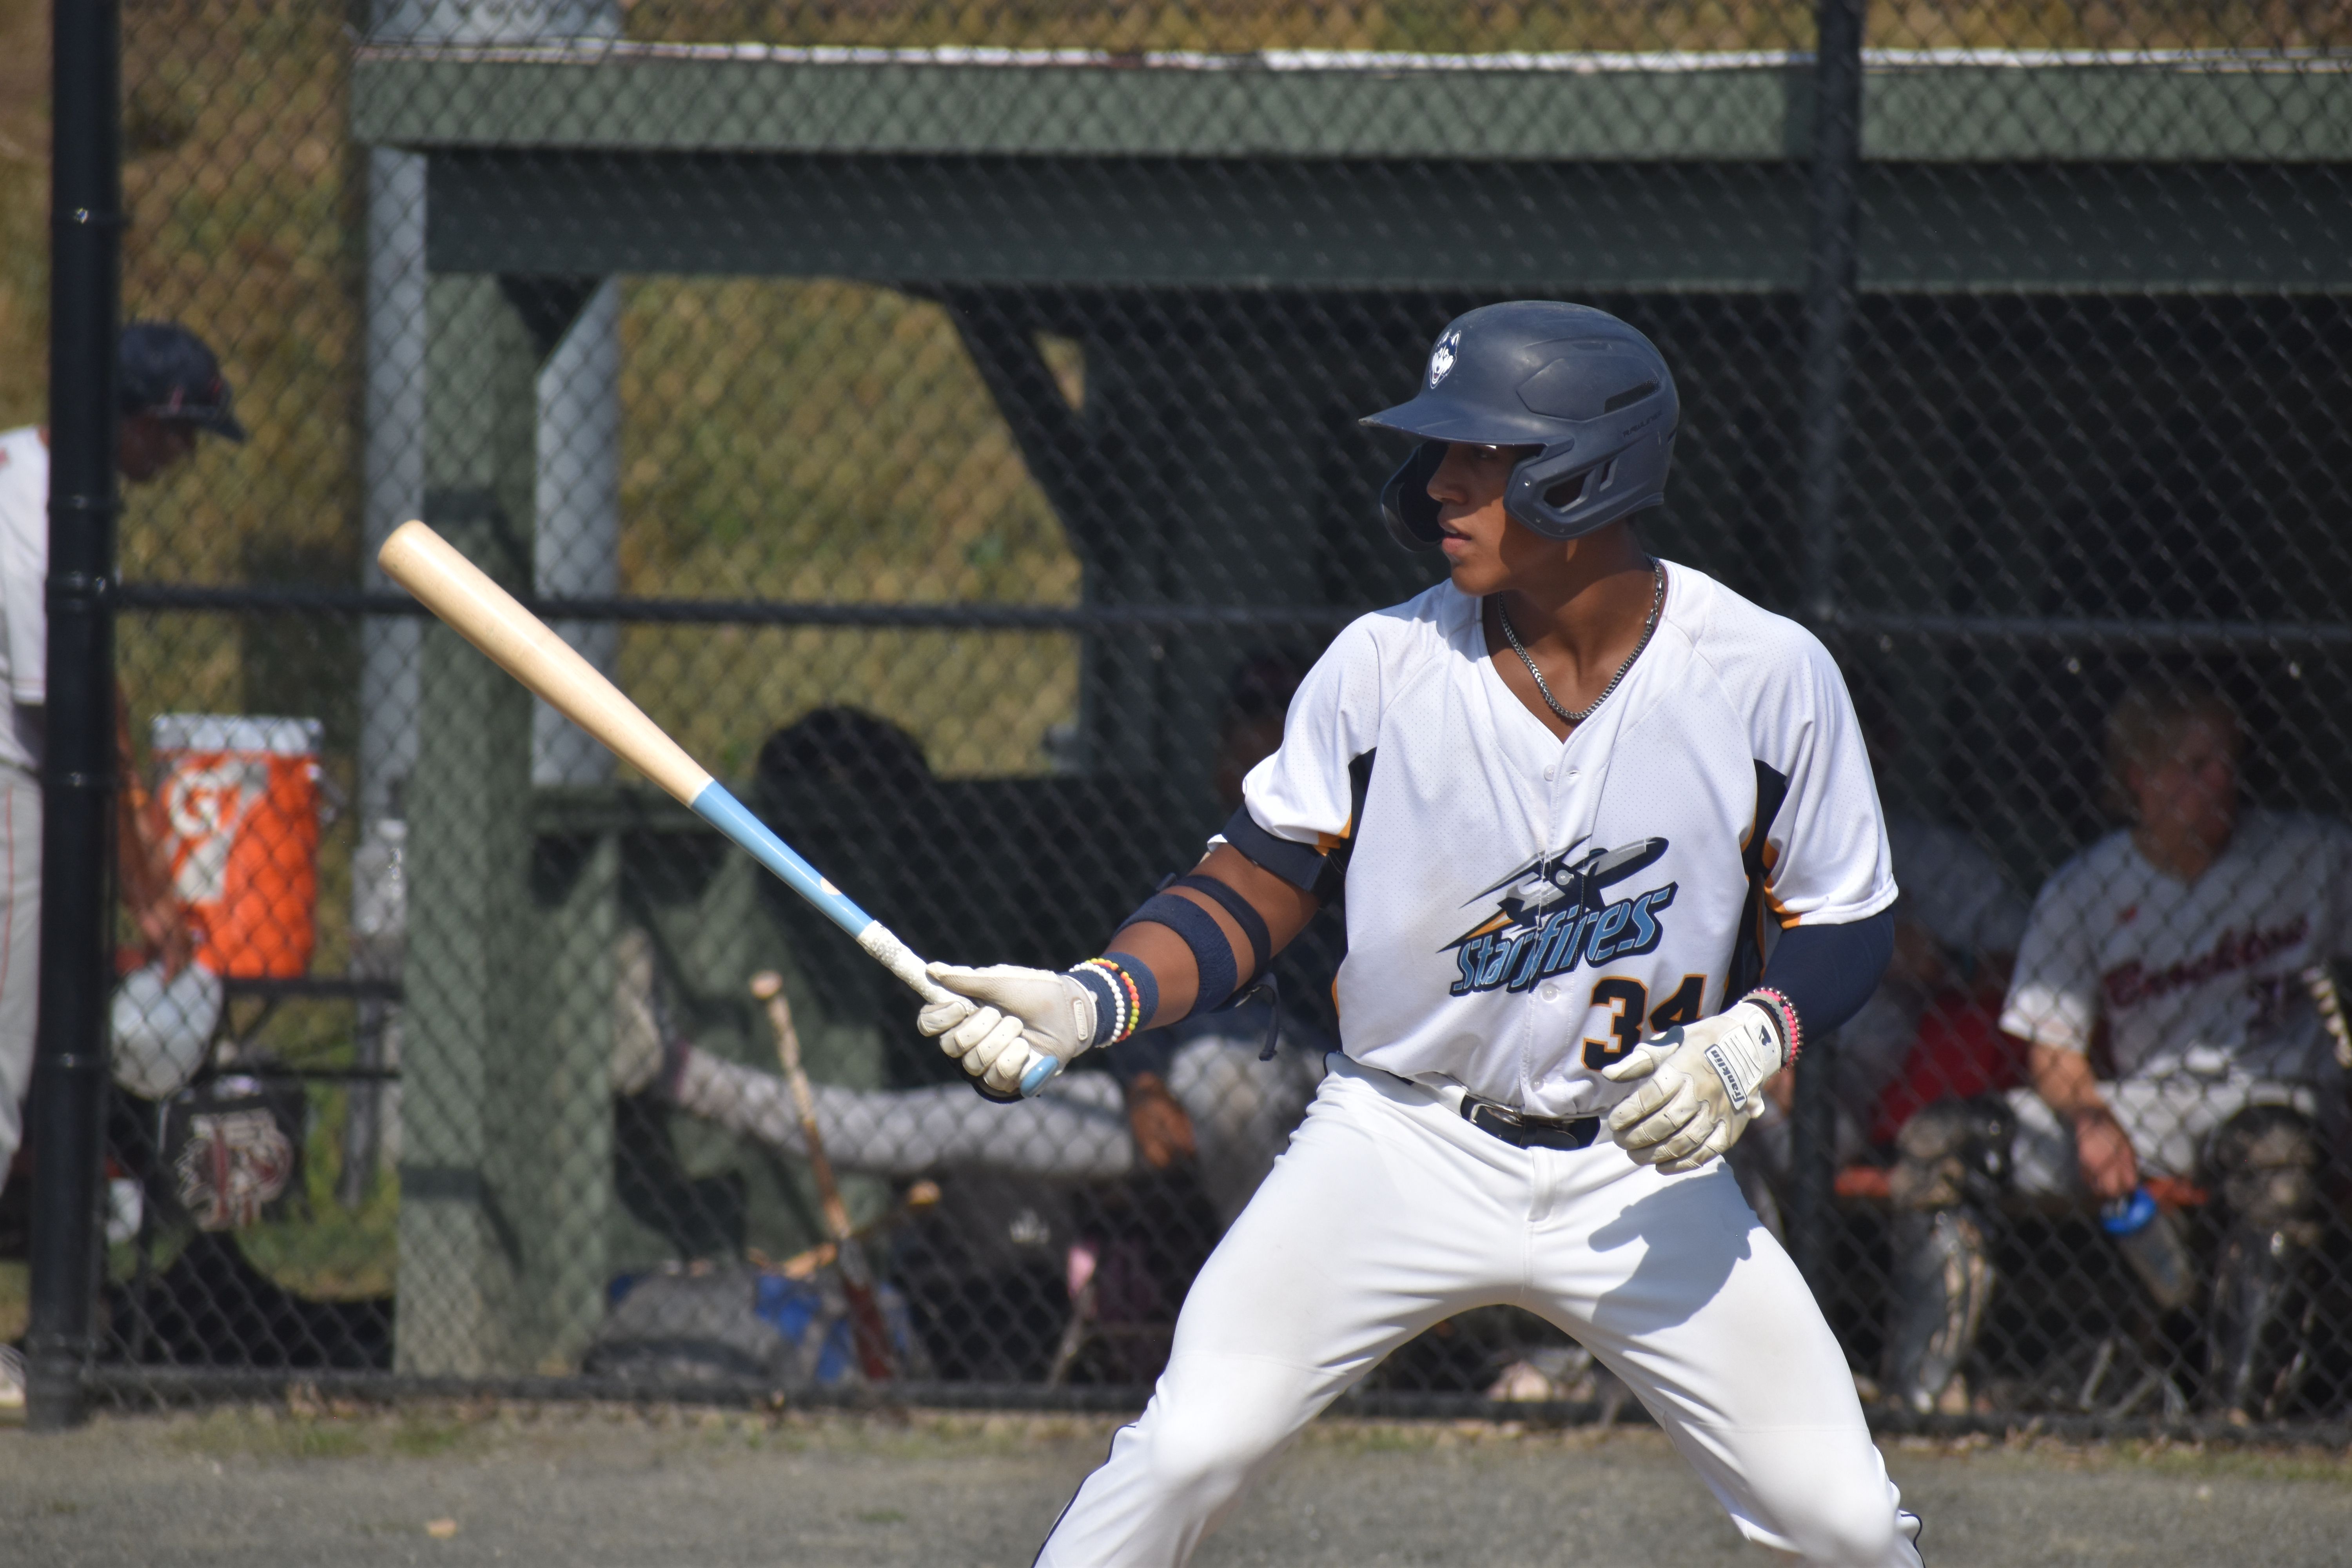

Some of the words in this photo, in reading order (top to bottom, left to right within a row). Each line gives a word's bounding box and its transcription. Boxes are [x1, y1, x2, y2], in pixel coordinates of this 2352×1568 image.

[1450, 881, 1679, 996] Starfires
[1581, 973, 1708, 1073] 34
[1711, 1049, 1745, 1103] Franklin
